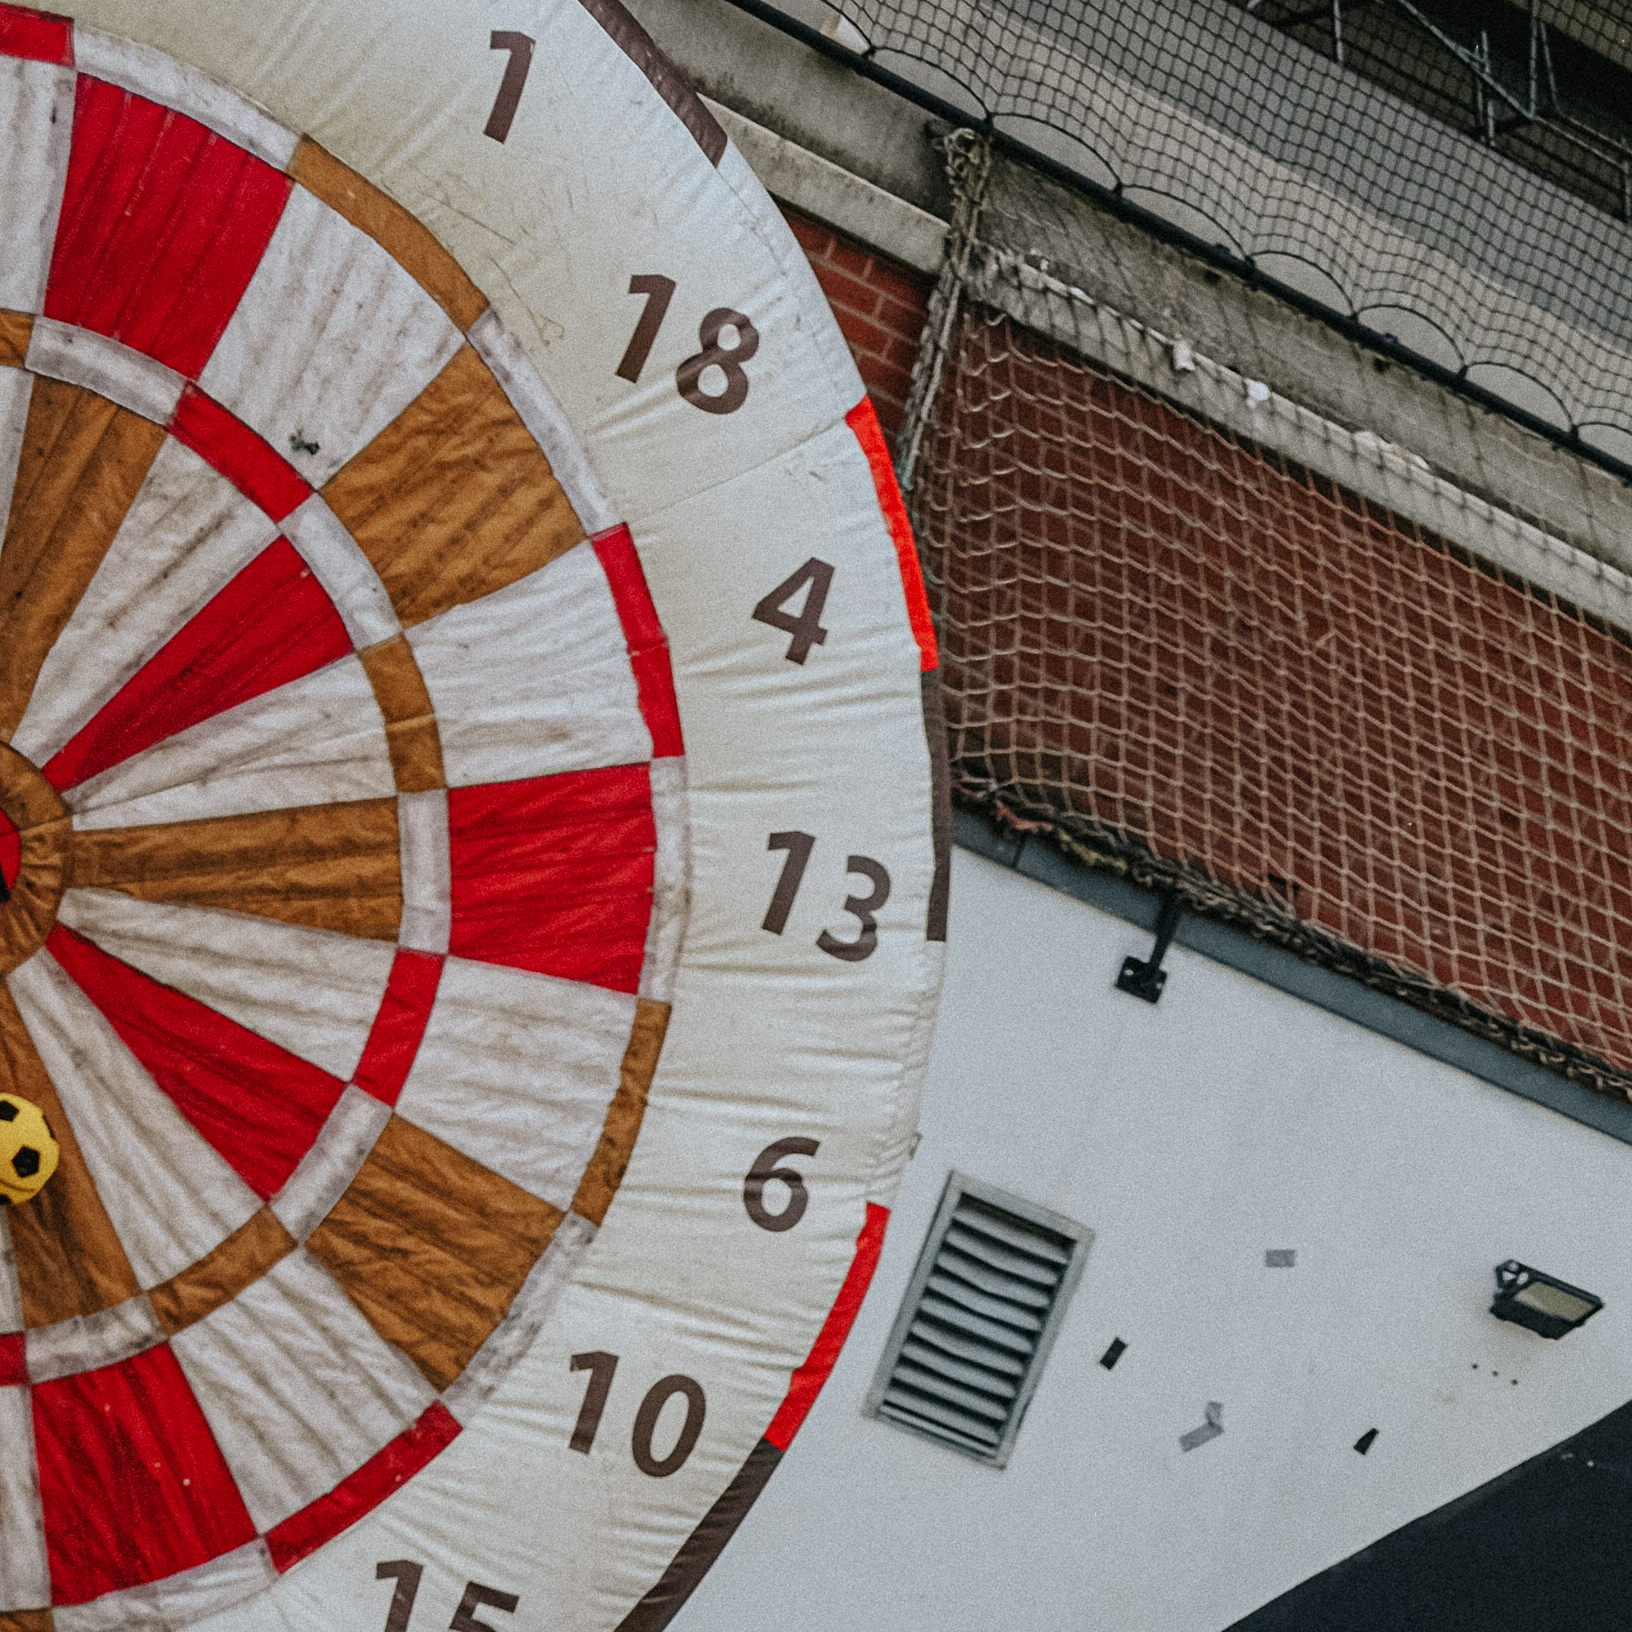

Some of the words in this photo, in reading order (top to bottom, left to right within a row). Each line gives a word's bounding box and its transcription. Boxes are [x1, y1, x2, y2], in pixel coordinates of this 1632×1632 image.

[483, 30, 534, 144] 1
[615, 273, 760, 414] 18
[752, 557, 836, 666] 4
[760, 830, 891, 961] 13
[741, 1136, 820, 1233] 6
[568, 1351, 707, 1477] 10
